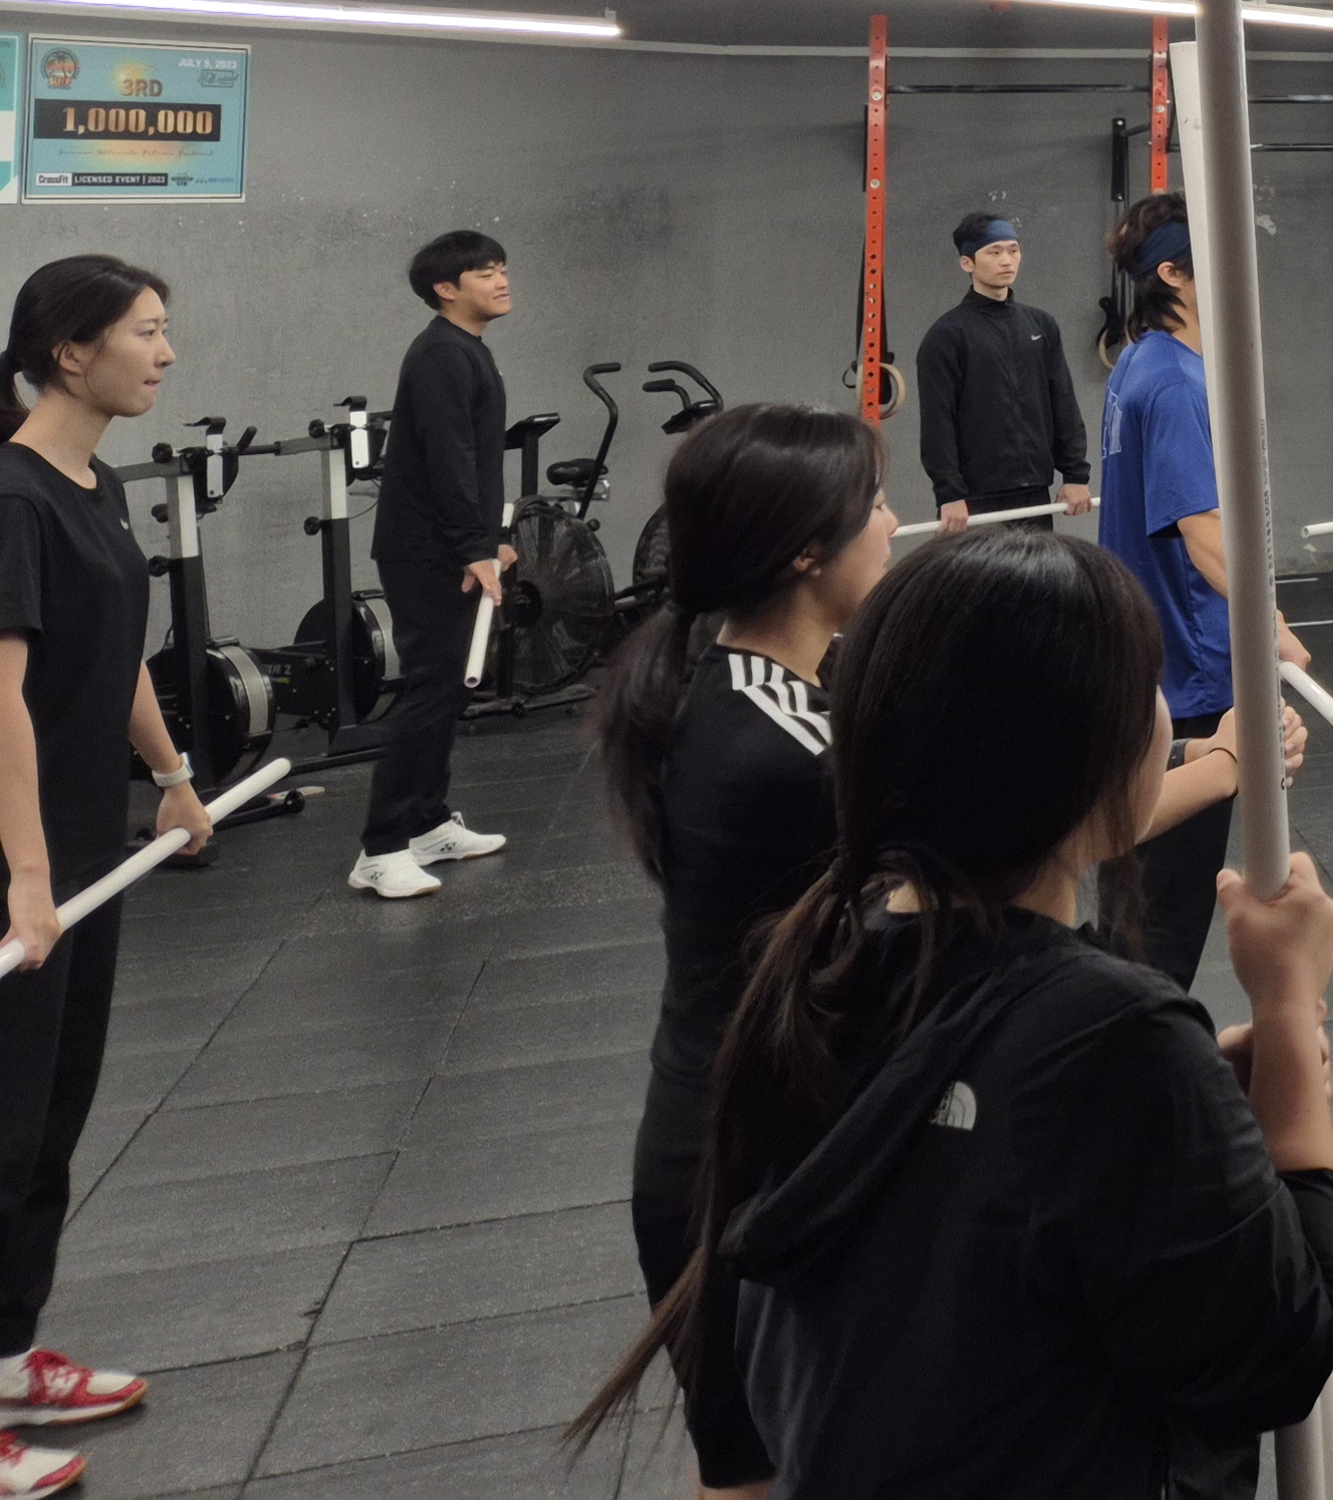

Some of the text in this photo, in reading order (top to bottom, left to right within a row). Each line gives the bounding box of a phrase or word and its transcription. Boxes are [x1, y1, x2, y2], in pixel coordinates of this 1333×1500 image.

[120, 78, 164, 98] 3RD
[61, 106, 214, 136] 1,000,000
[74, 175, 113, 184] LICENSED
[115, 175, 140, 184] EVENT
